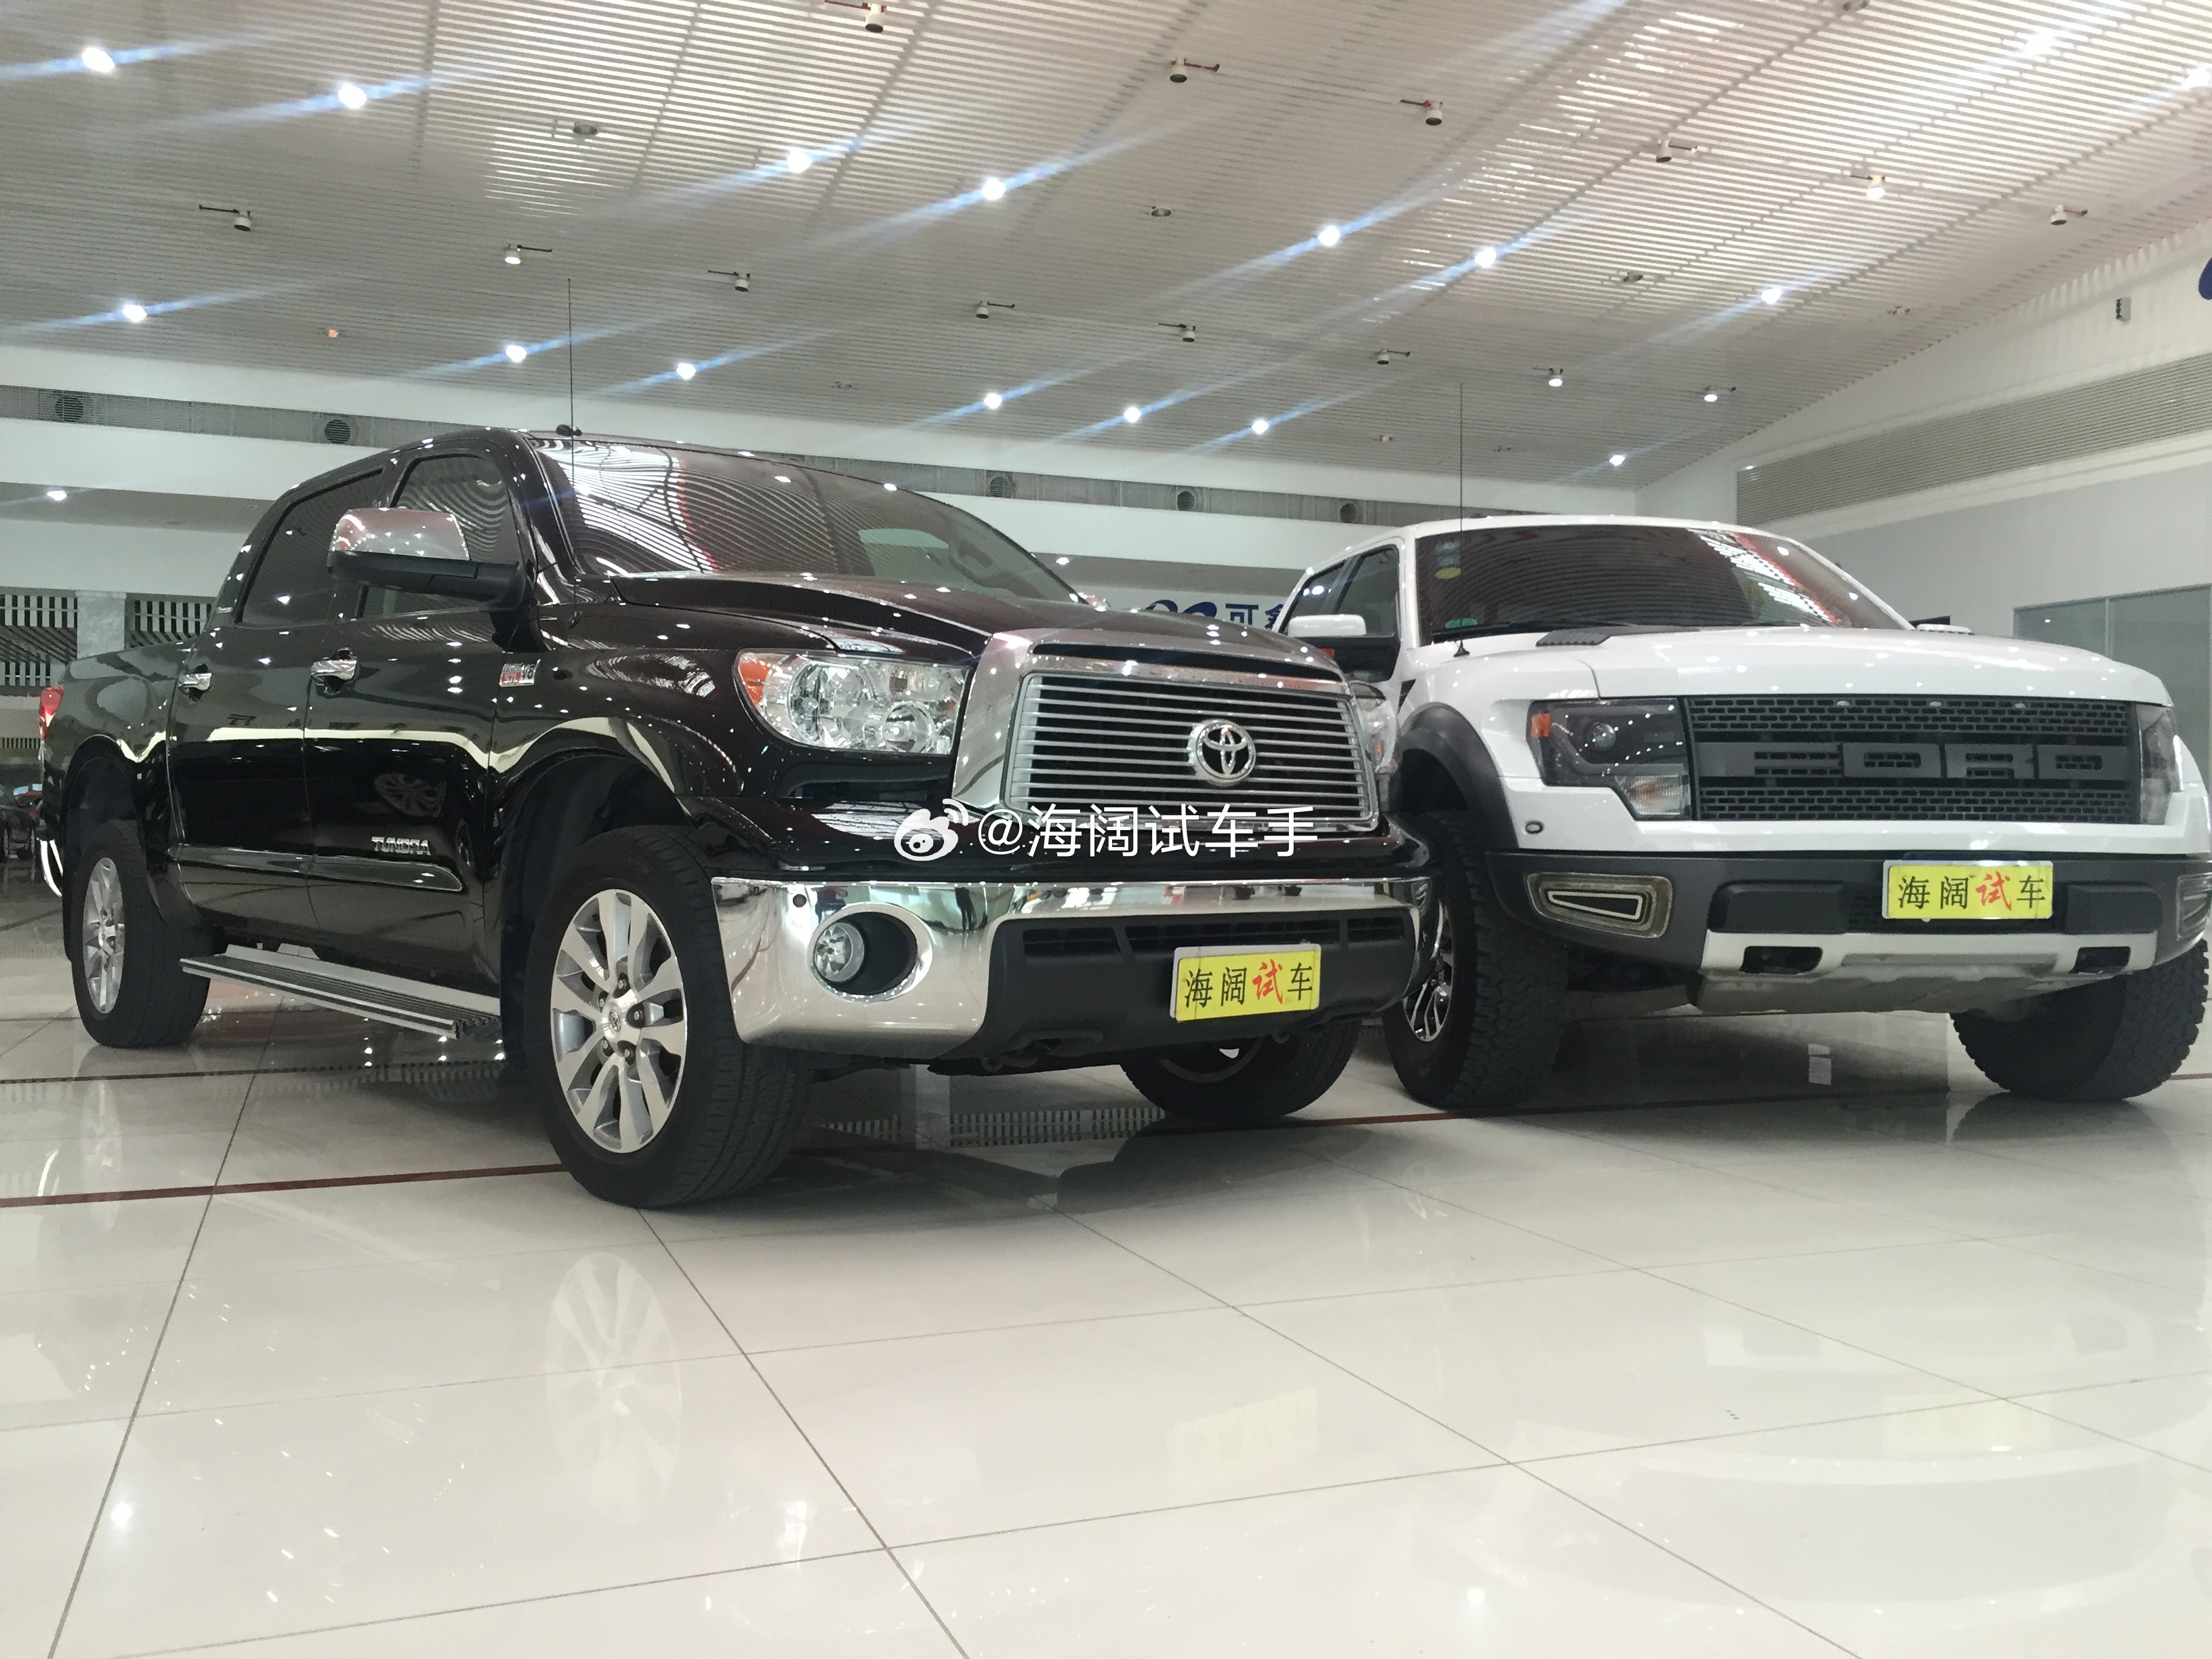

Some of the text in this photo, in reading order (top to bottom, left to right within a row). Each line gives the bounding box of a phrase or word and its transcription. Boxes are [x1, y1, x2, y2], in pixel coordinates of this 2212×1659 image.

[1696, 743, 2129, 779] FORD
[371, 836, 431, 855] TUNDRA
[1898, 870, 2045, 911] 海阔试车
[1184, 958, 1313, 1008] 海阔试车
